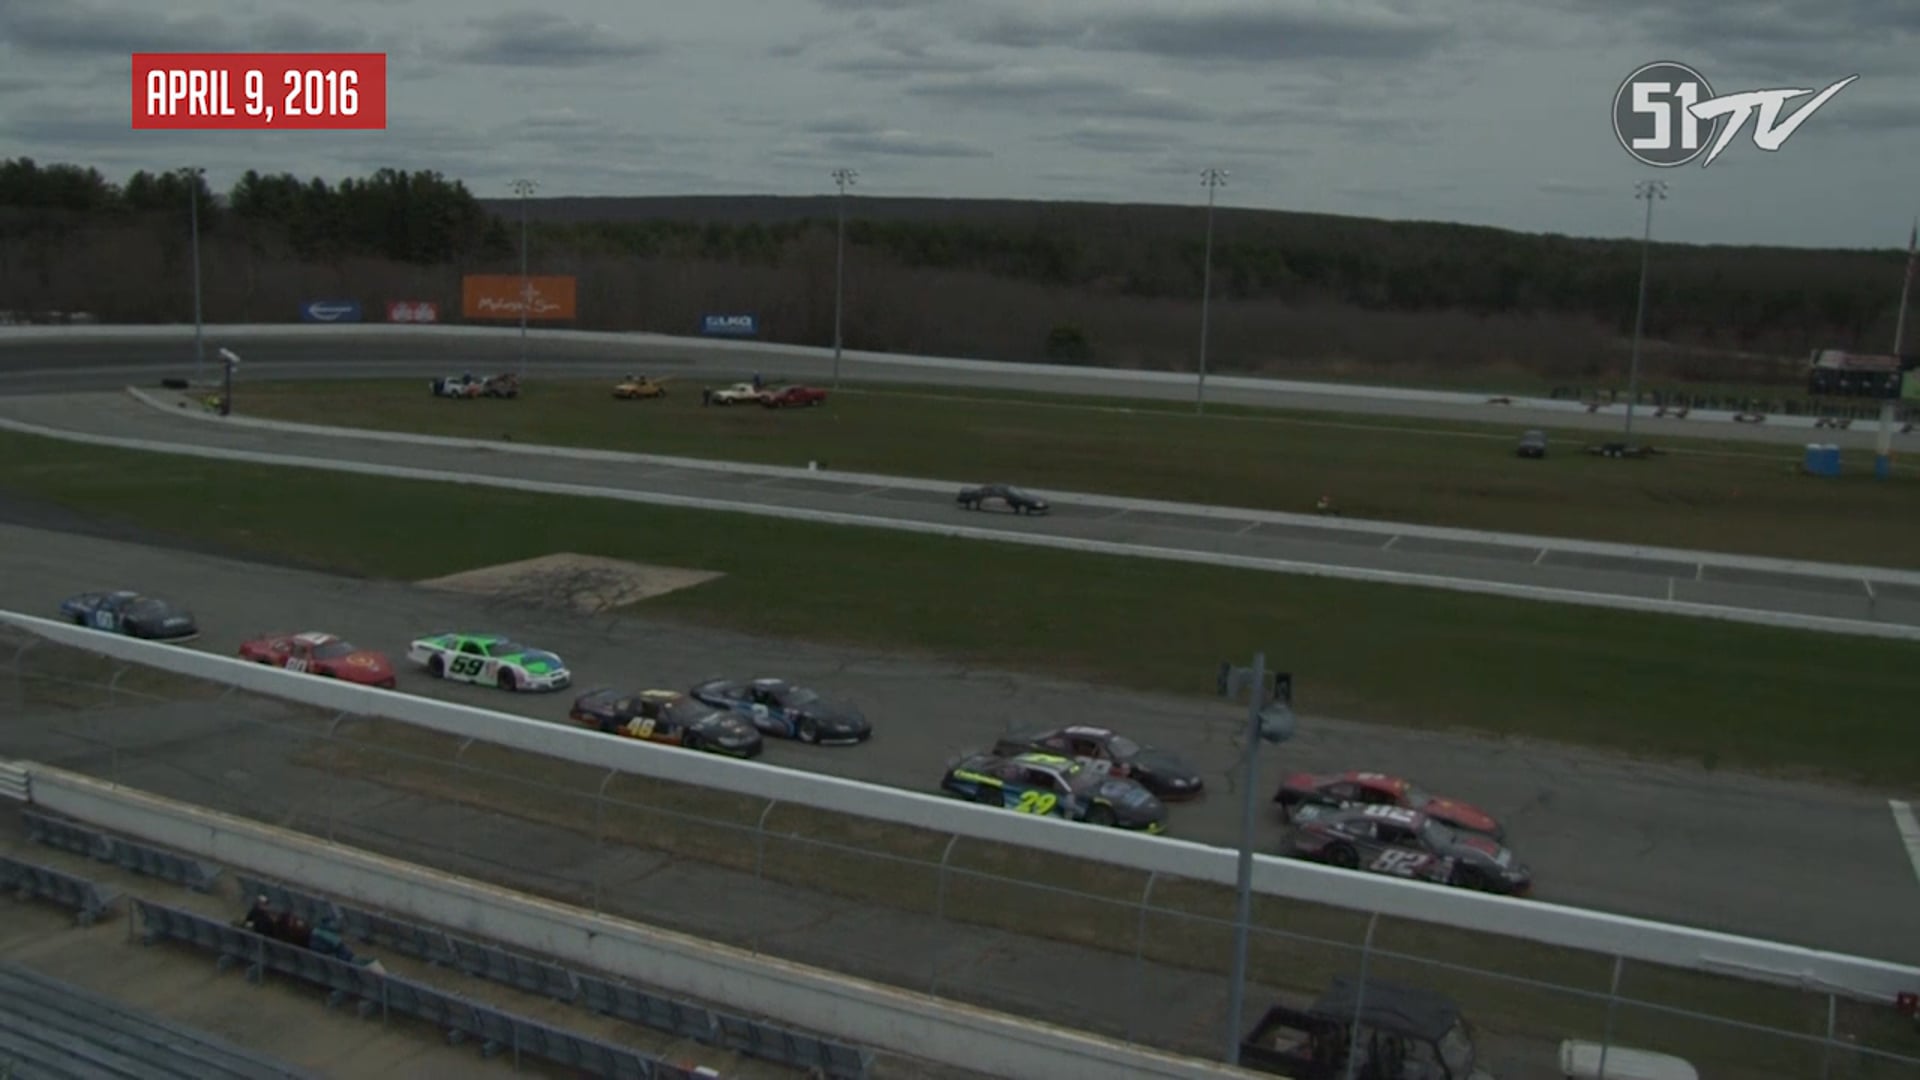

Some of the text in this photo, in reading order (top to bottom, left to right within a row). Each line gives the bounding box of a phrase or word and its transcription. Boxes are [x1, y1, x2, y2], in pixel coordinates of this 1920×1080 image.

[448, 654, 486, 676] 59
[627, 715, 657, 739] 48
[1018, 790, 1057, 815] 29
